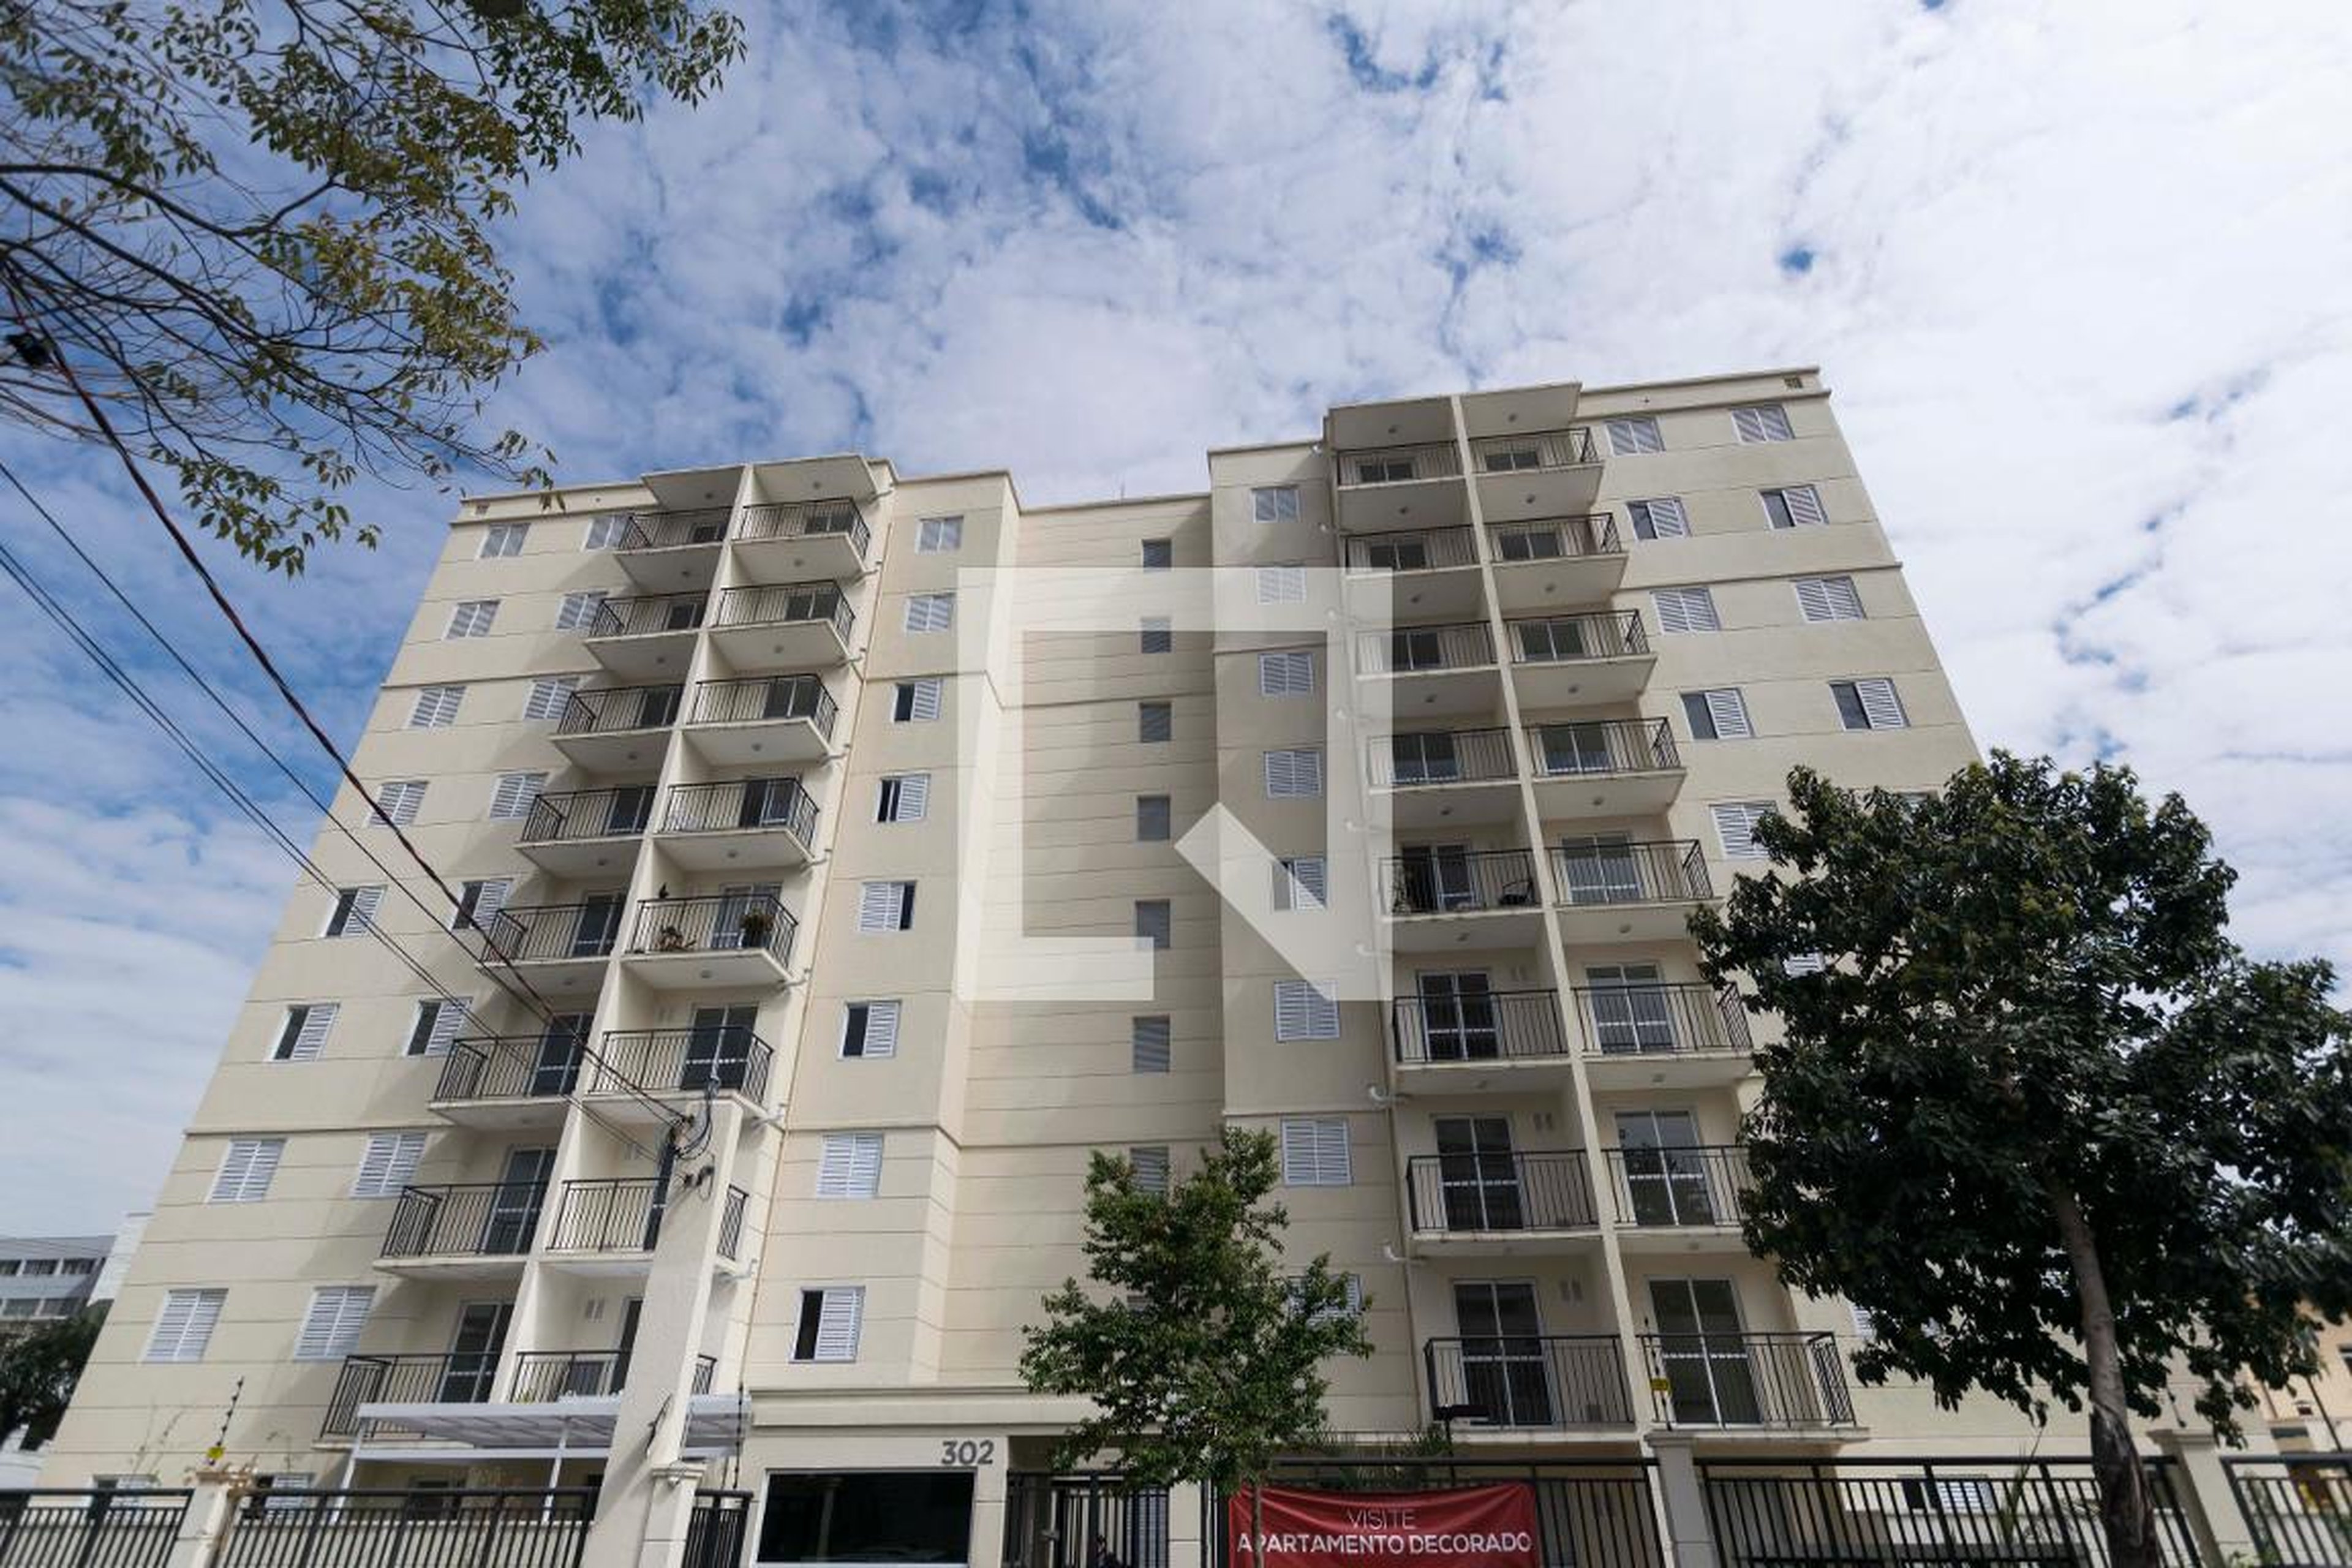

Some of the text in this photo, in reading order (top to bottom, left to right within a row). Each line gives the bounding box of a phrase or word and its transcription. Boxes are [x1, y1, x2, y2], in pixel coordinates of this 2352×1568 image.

[942, 1439, 994, 1464] 302
[1347, 1509, 1416, 1530] VISITE
[1409, 1532, 1531, 1553] DECORADO
